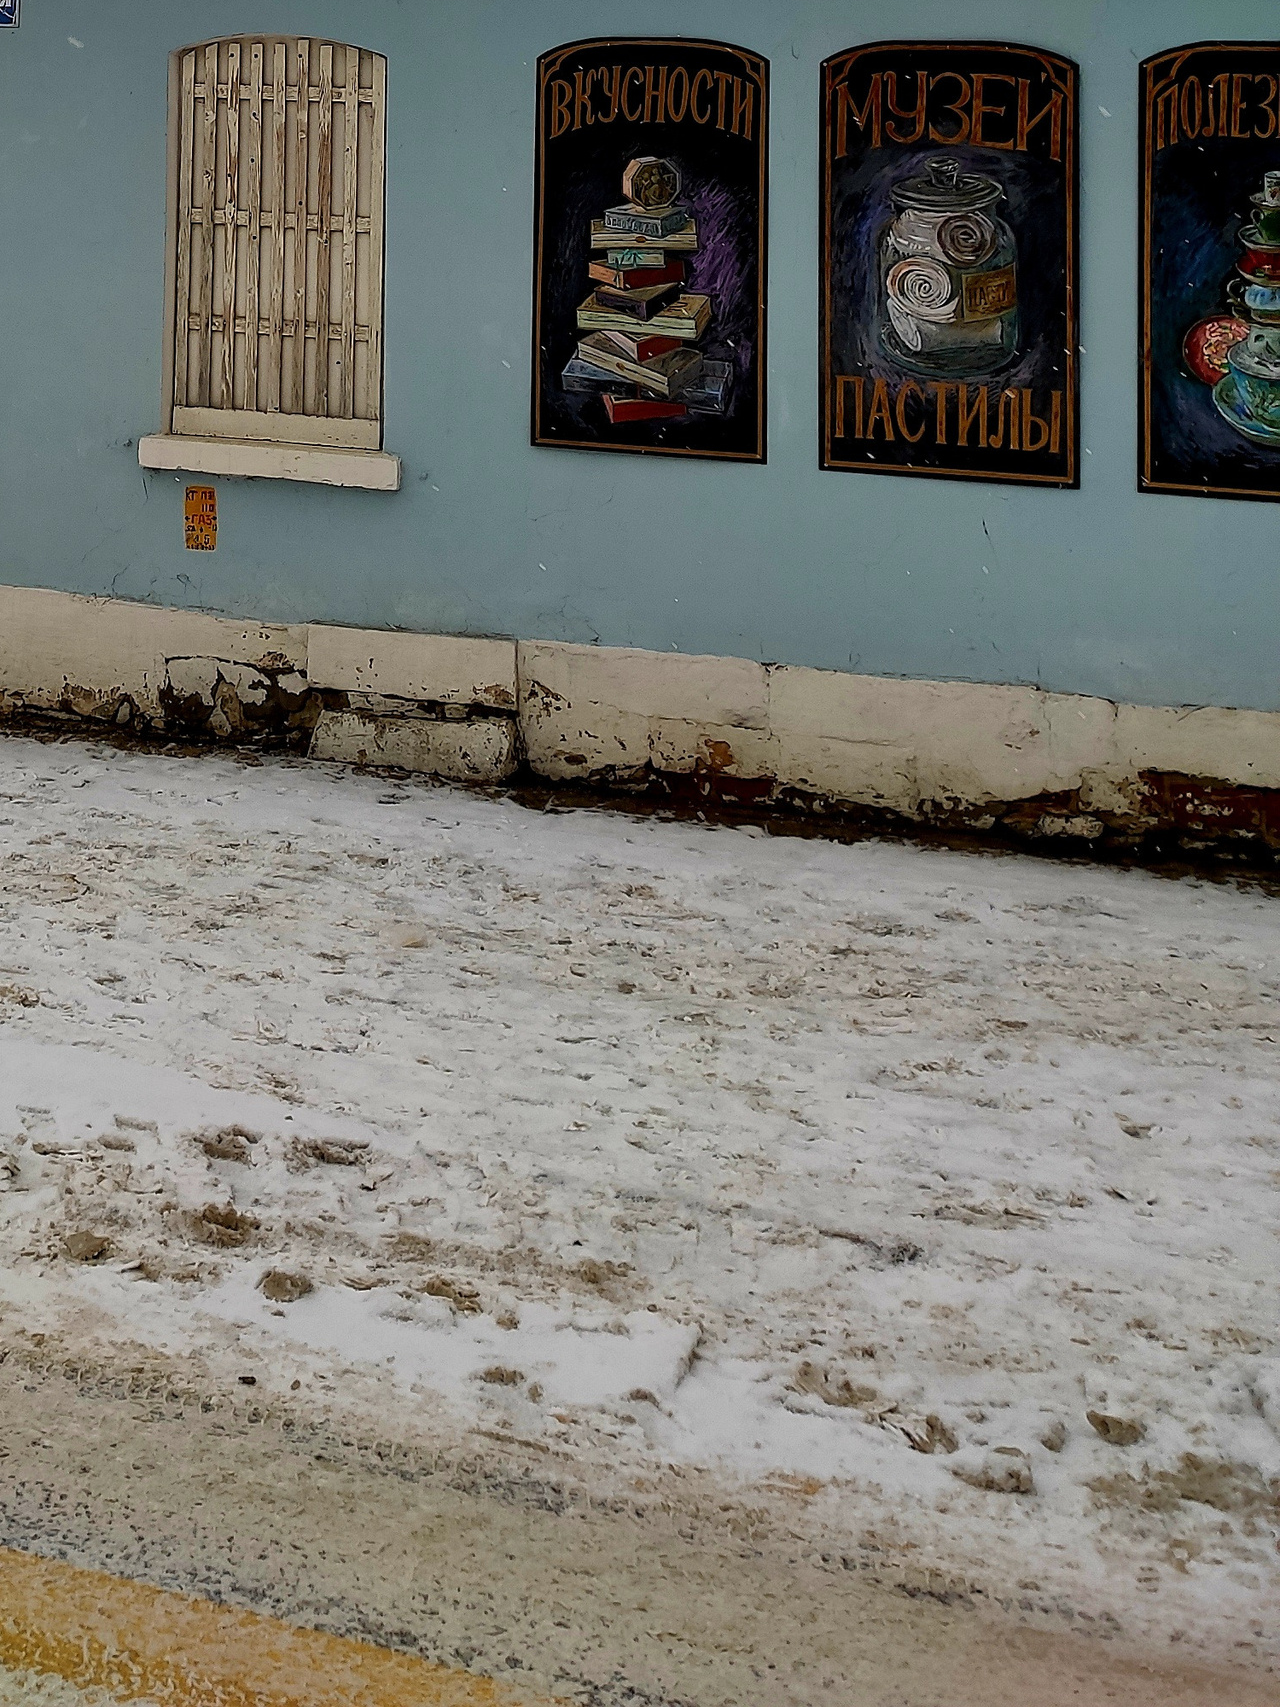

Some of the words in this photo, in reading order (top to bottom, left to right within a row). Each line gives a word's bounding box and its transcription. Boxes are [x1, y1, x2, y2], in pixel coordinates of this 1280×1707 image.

[549, 65, 754, 141] ВКУСНОСТИ
[834, 70, 1064, 163] МУЗЕЙ
[1156, 72, 1280, 151] ПОЛЕЗ
[834, 375, 1063, 453] ПАСТИЛЫ
[191, 514, 212, 525] ГАЗ
